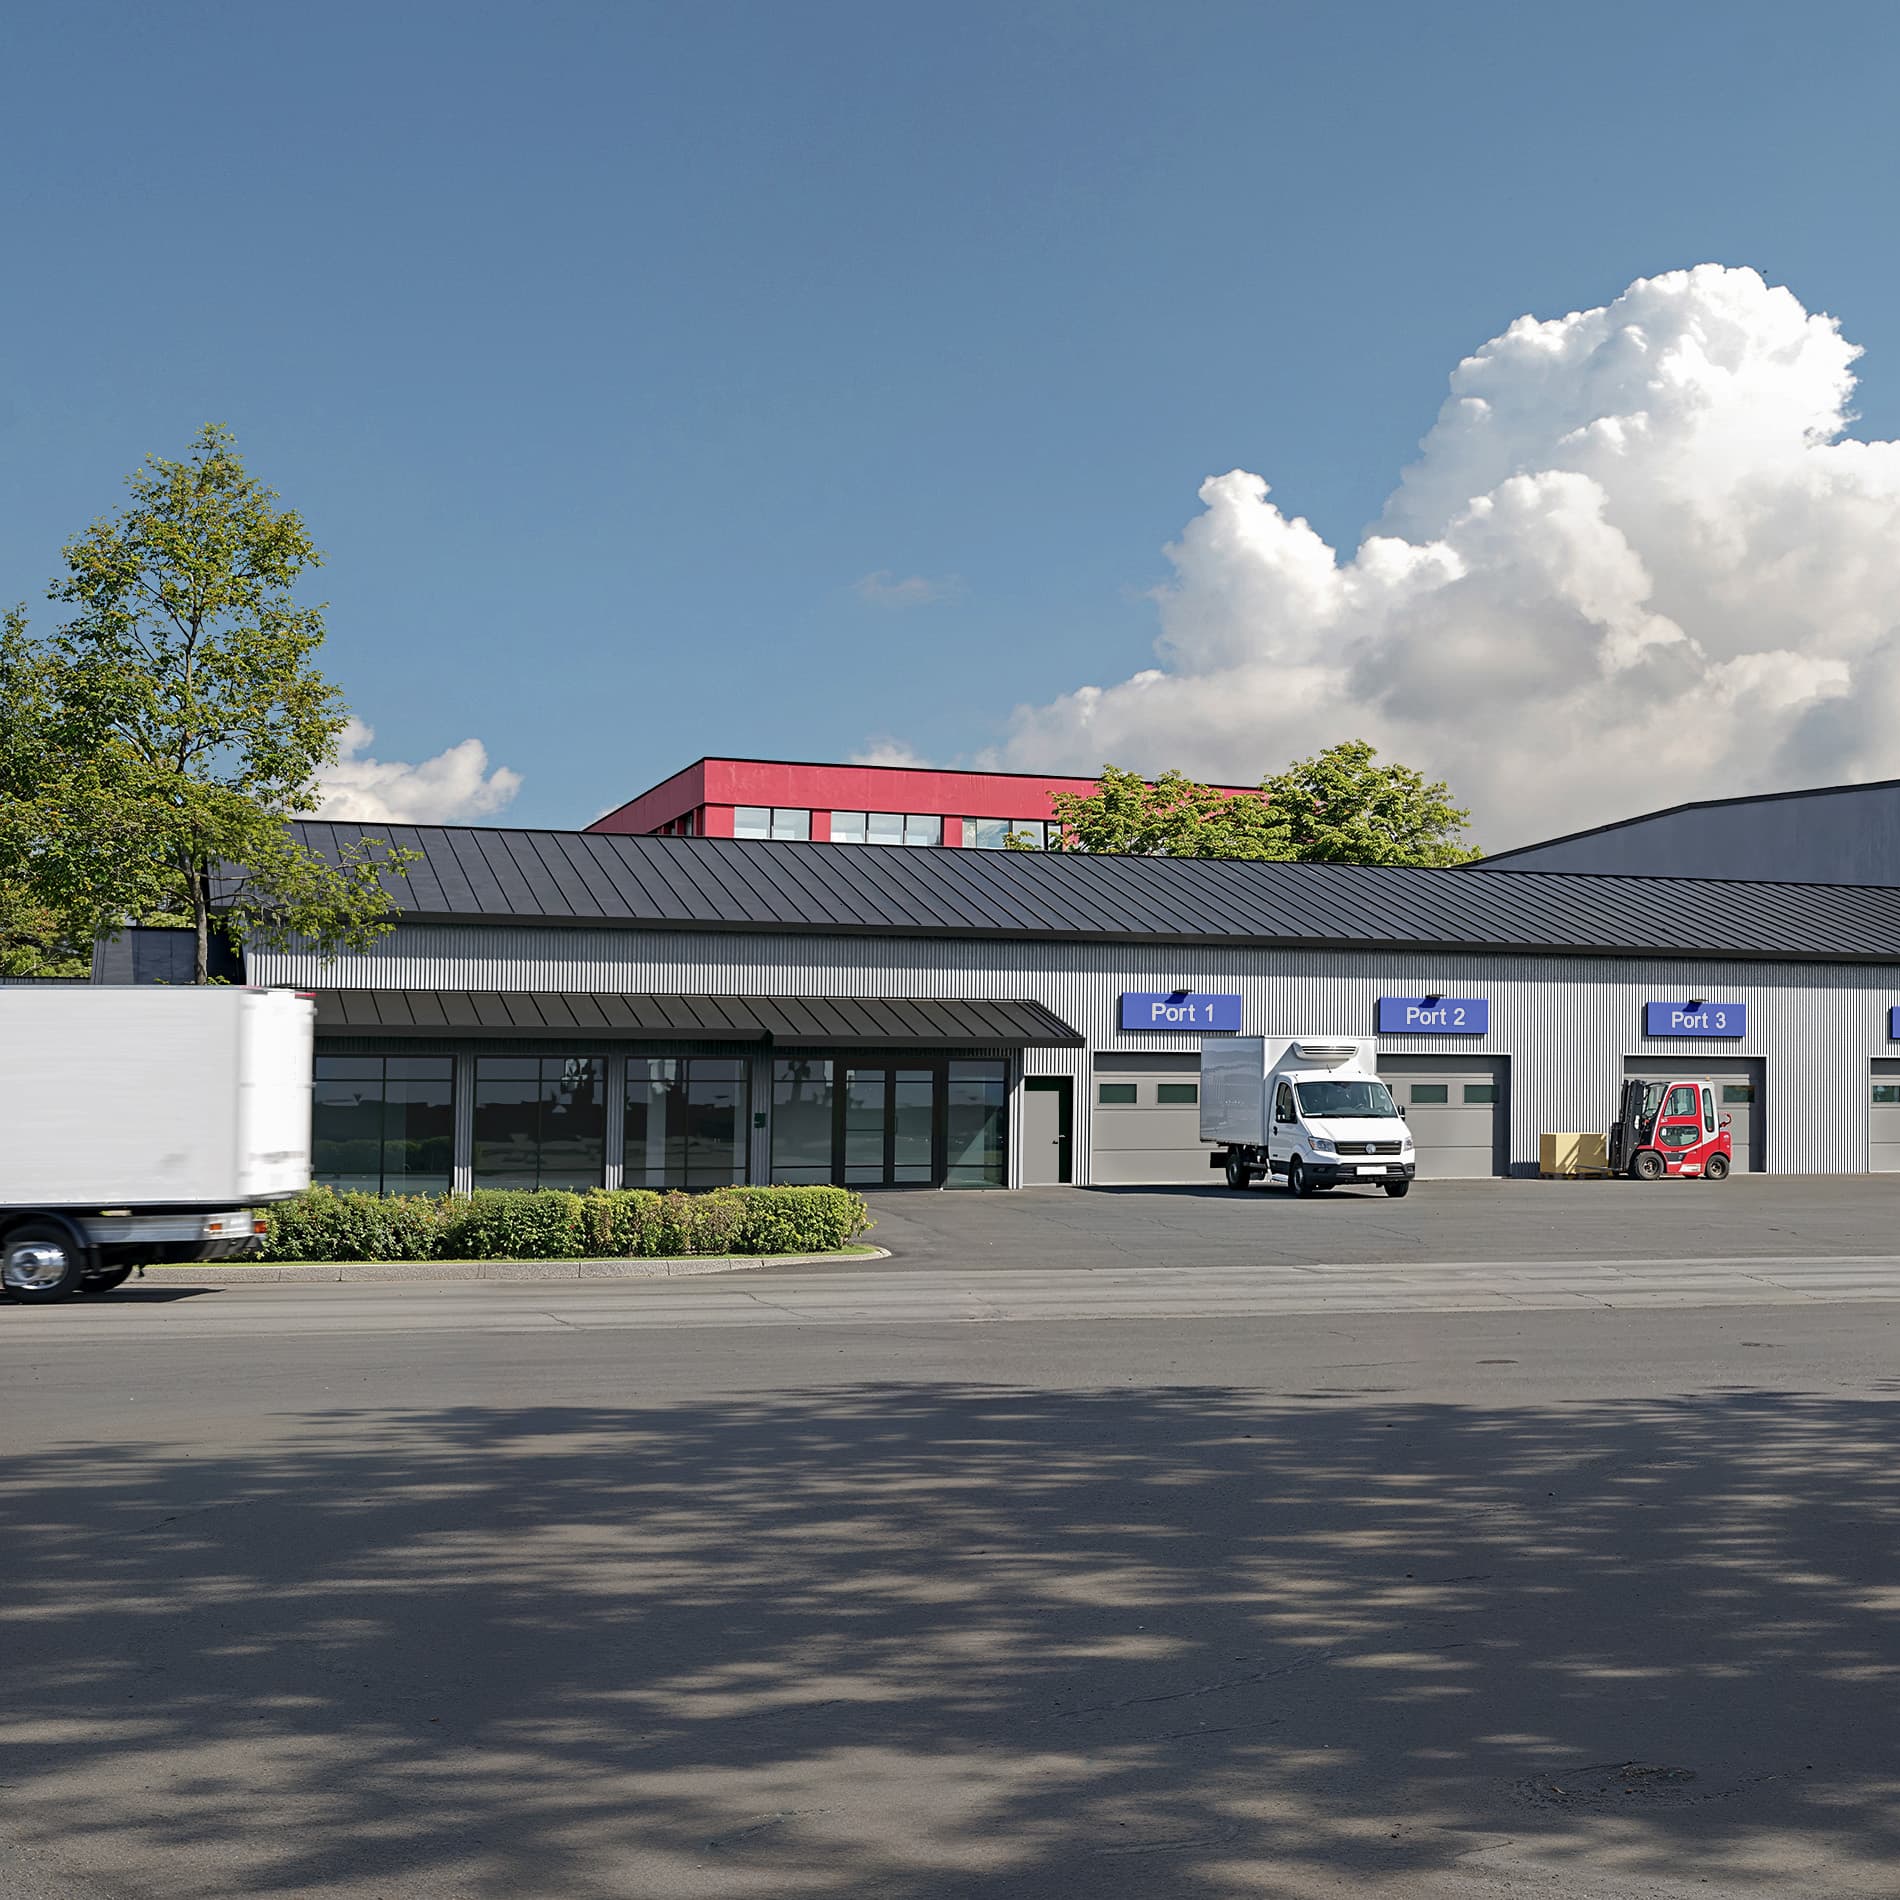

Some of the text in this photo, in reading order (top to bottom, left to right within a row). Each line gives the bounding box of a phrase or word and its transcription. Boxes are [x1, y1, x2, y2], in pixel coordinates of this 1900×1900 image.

[1151, 1003, 1214, 1022] Port 1
[1406, 1007, 1466, 1025] Port 2
[1671, 1011, 1727, 1030] Port 3
